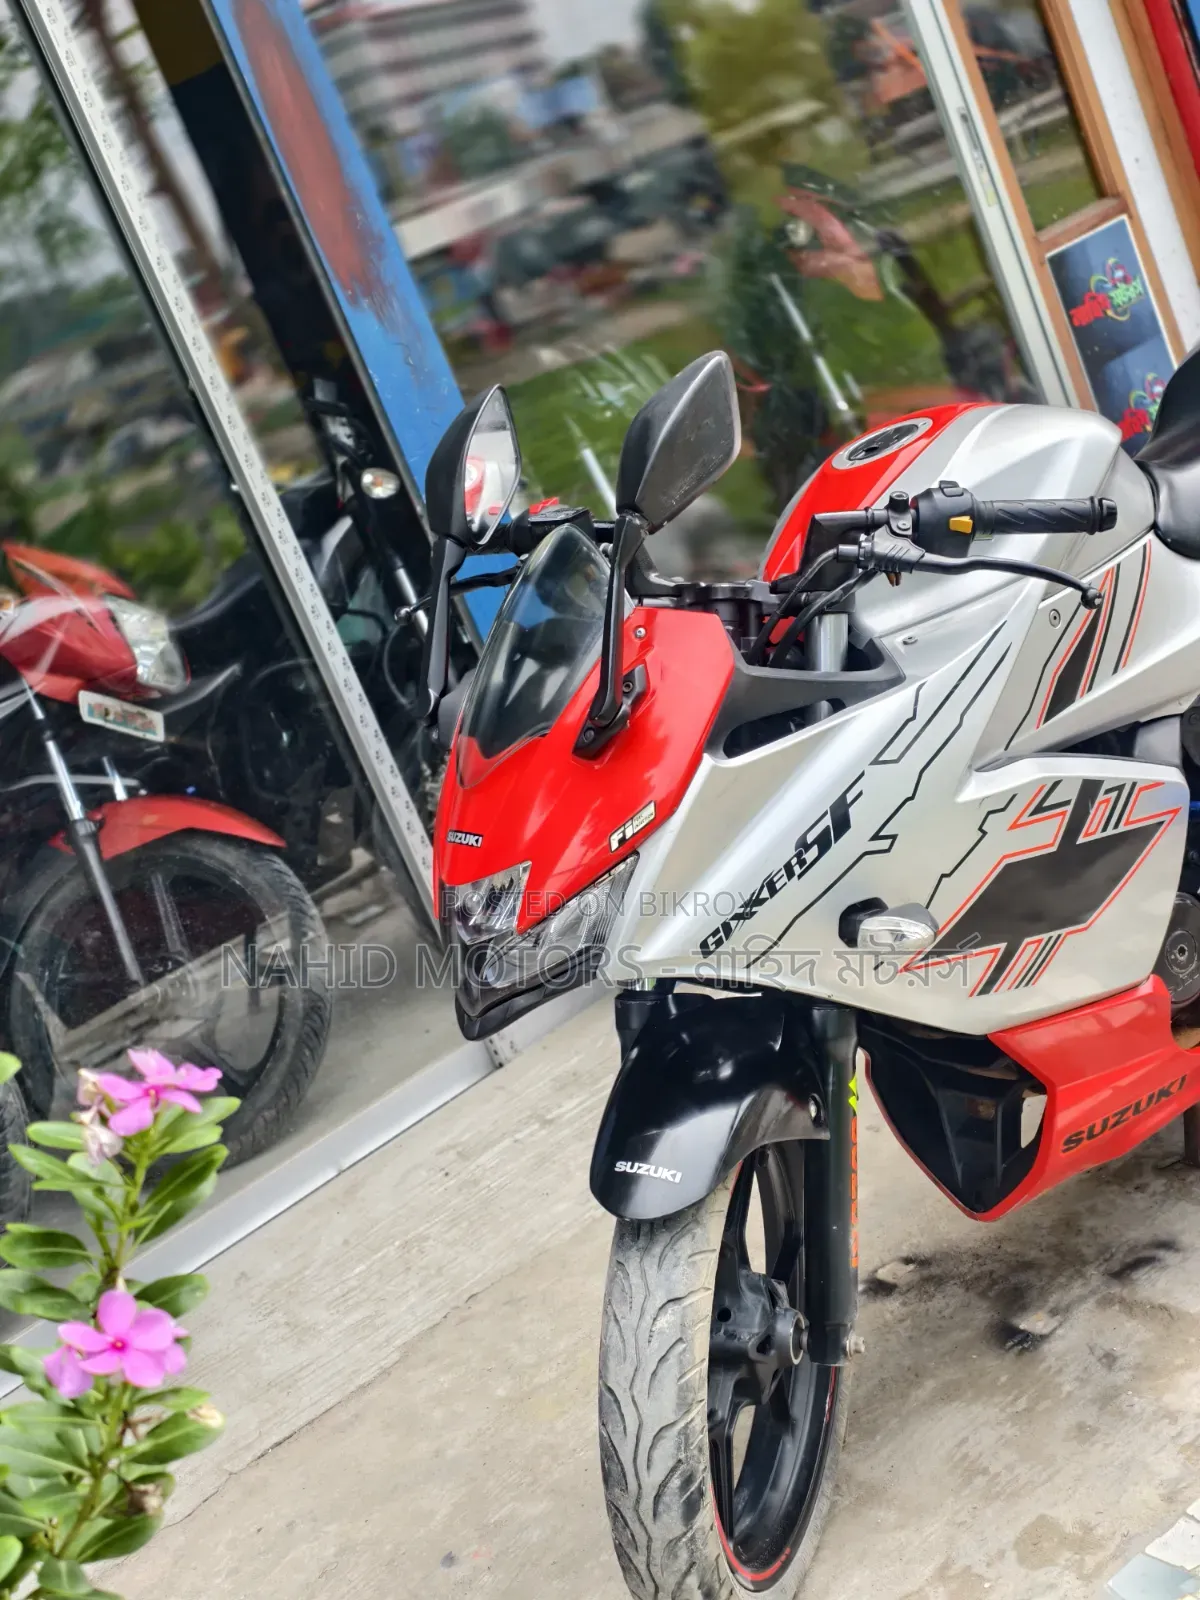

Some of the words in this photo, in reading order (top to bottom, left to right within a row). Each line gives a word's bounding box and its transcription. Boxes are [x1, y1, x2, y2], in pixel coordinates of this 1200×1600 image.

[446, 830, 484, 848] SUZUKI
[1061, 1074, 1188, 1154] SUZUKI
[613, 1160, 683, 1184] SUZUKI
